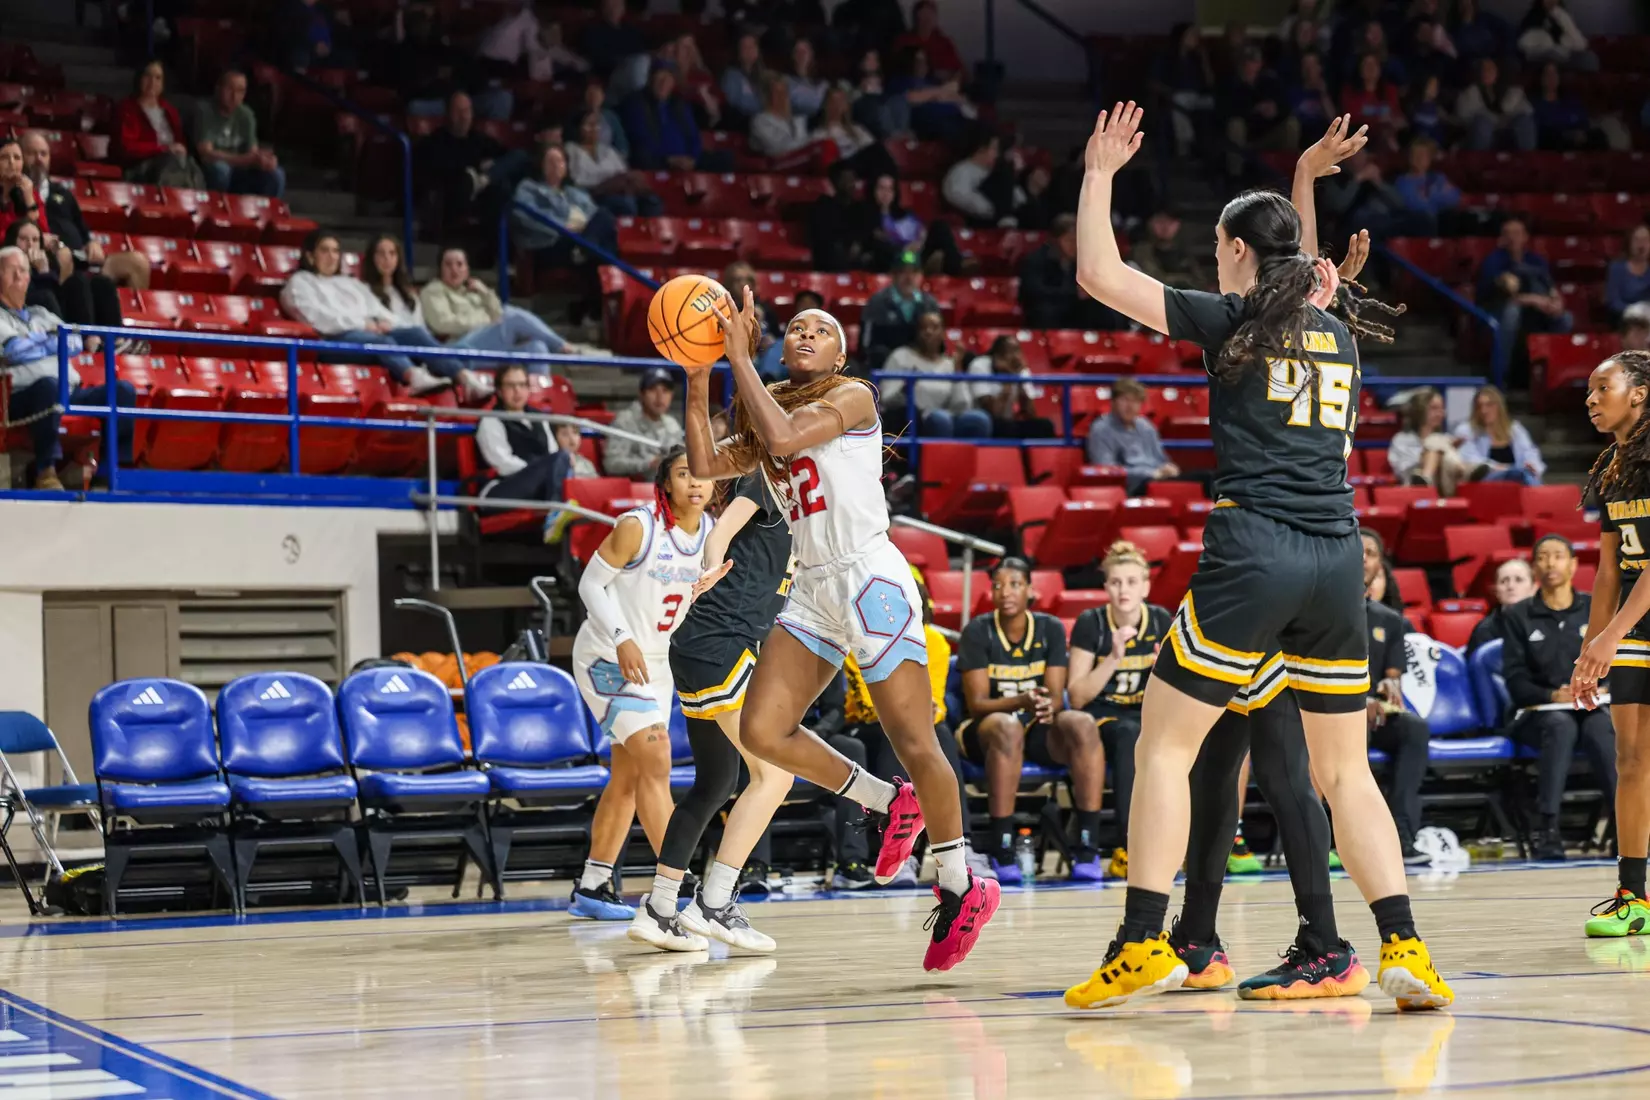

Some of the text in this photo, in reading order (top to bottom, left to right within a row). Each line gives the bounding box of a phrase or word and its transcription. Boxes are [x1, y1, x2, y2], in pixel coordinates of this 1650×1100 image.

[1265, 356, 1353, 430] 45
[657, 594, 683, 632] 3
[1115, 671, 1141, 694] 11
